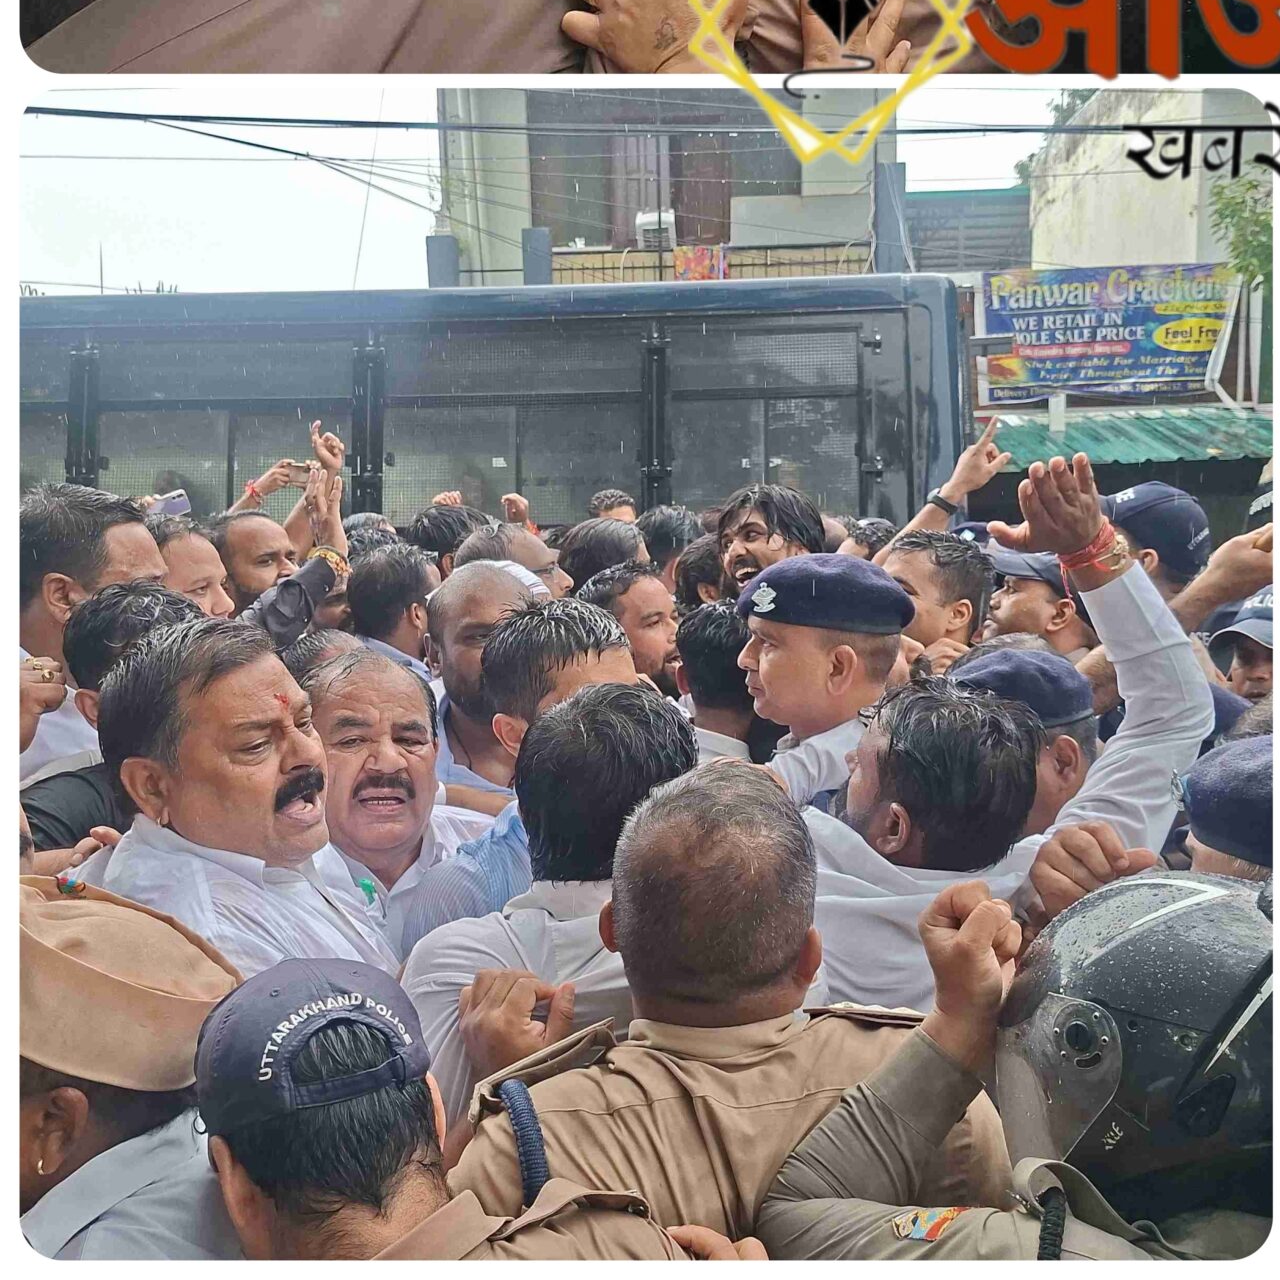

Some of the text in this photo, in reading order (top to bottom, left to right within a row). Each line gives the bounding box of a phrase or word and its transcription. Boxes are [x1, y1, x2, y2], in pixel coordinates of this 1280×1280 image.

[990, 274, 1100, 310] Panwar
[1012, 312, 1122, 331] WE RETAIL IN
[1055, 328, 1092, 343] SALE
[1096, 325, 1146, 341] PRICE
[1165, 327, 1192, 339] Feel
[258, 992, 414, 1081] UTTARAKHAND POLICE
